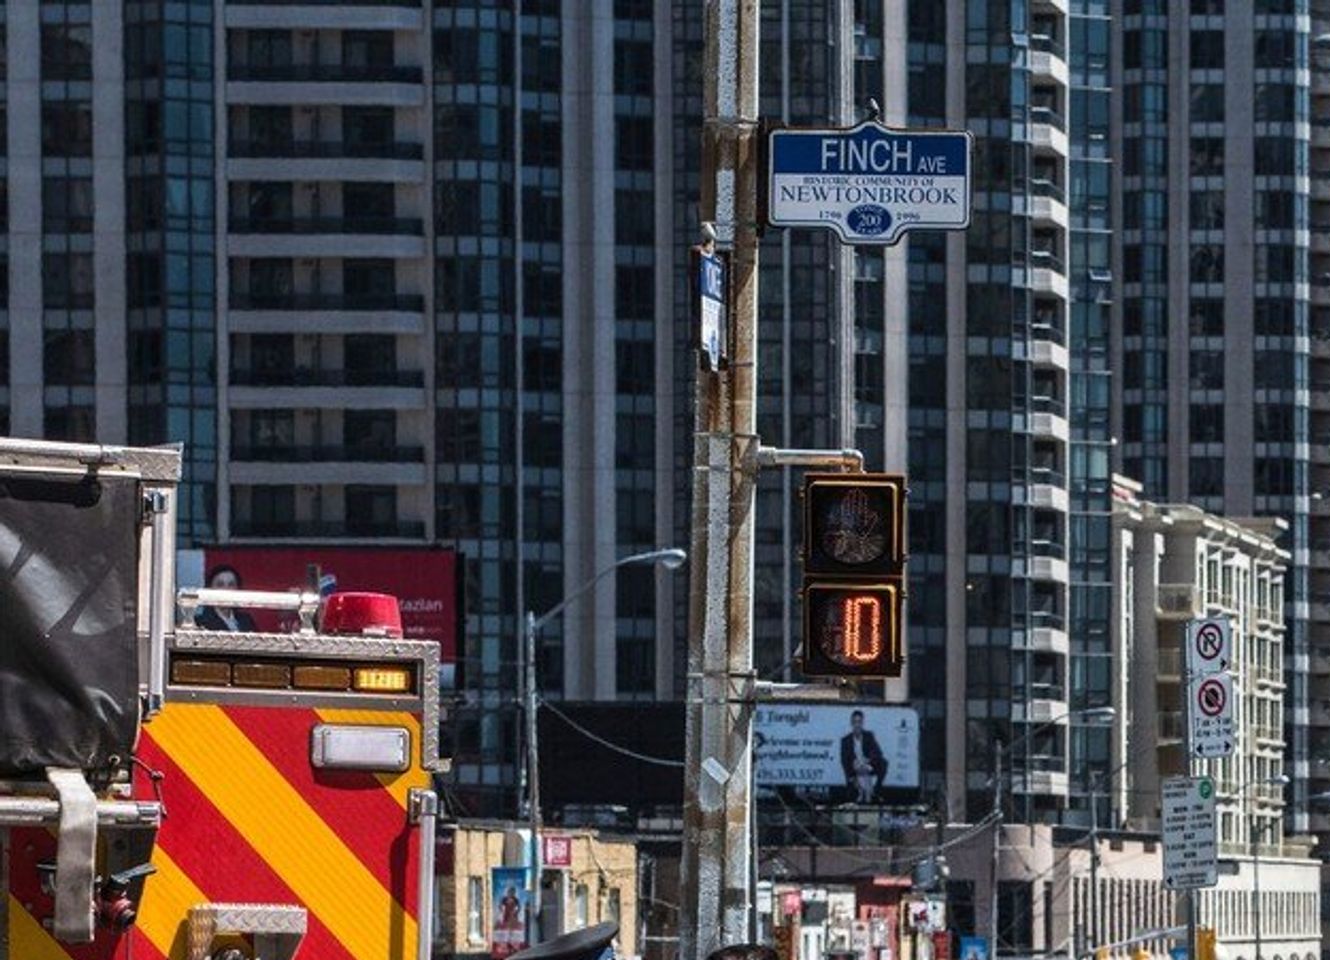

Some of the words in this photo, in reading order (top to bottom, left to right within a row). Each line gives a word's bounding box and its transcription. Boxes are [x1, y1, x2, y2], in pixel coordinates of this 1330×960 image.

[821, 139, 912, 172] FINCH
[917, 156, 947, 173] AVE
[802, 176, 850, 186] HISTORIC
[855, 177, 920, 187] COMMUNITY
[921, 178, 934, 187] OF
[780, 185, 957, 204] NEWTONBROOK
[859, 214, 881, 227] 200
[845, 596, 880, 662] 10
